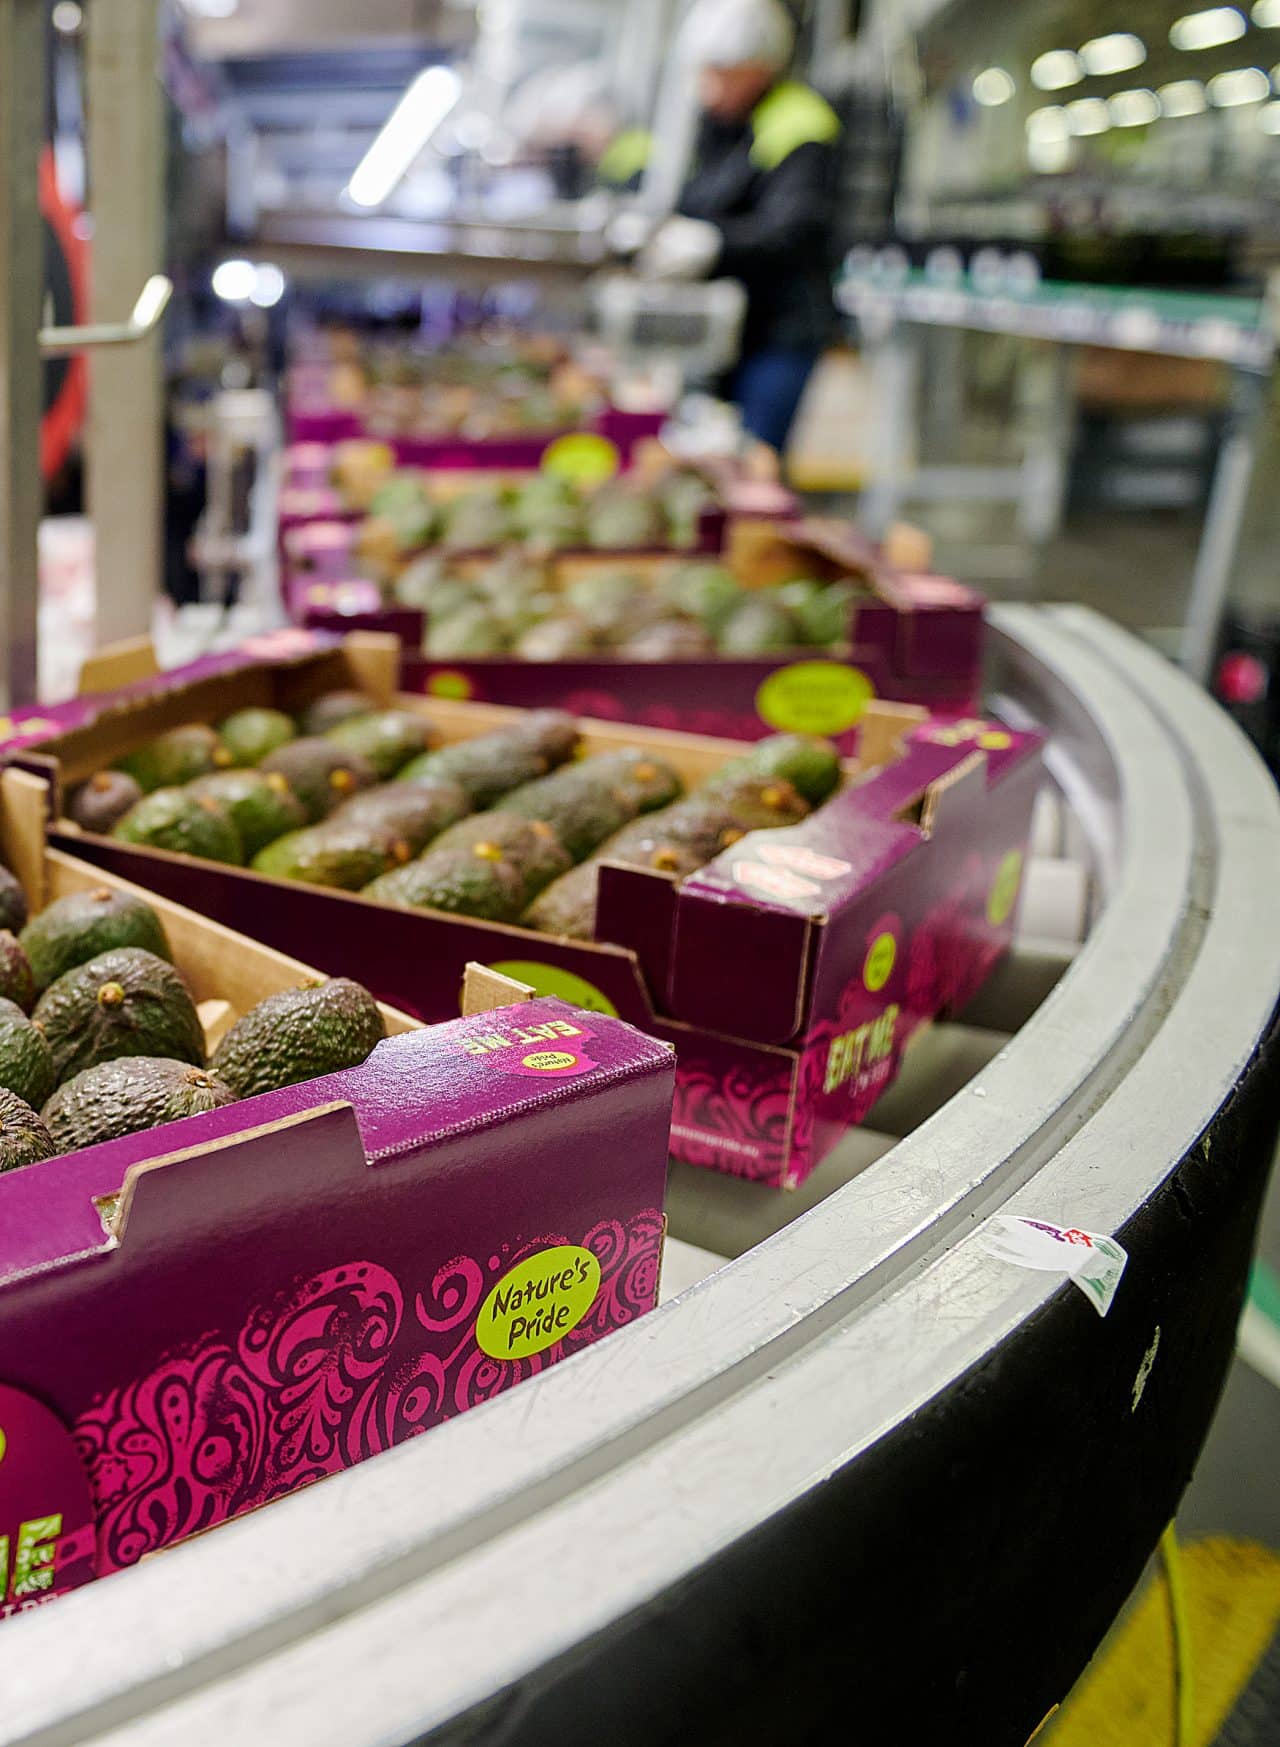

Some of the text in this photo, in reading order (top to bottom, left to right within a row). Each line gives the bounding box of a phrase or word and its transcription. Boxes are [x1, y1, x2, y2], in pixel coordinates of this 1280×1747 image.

[512, 1020, 582, 1045] EAT
[490, 1256, 591, 1323] Nature's
[507, 1302, 570, 1351] Pride
